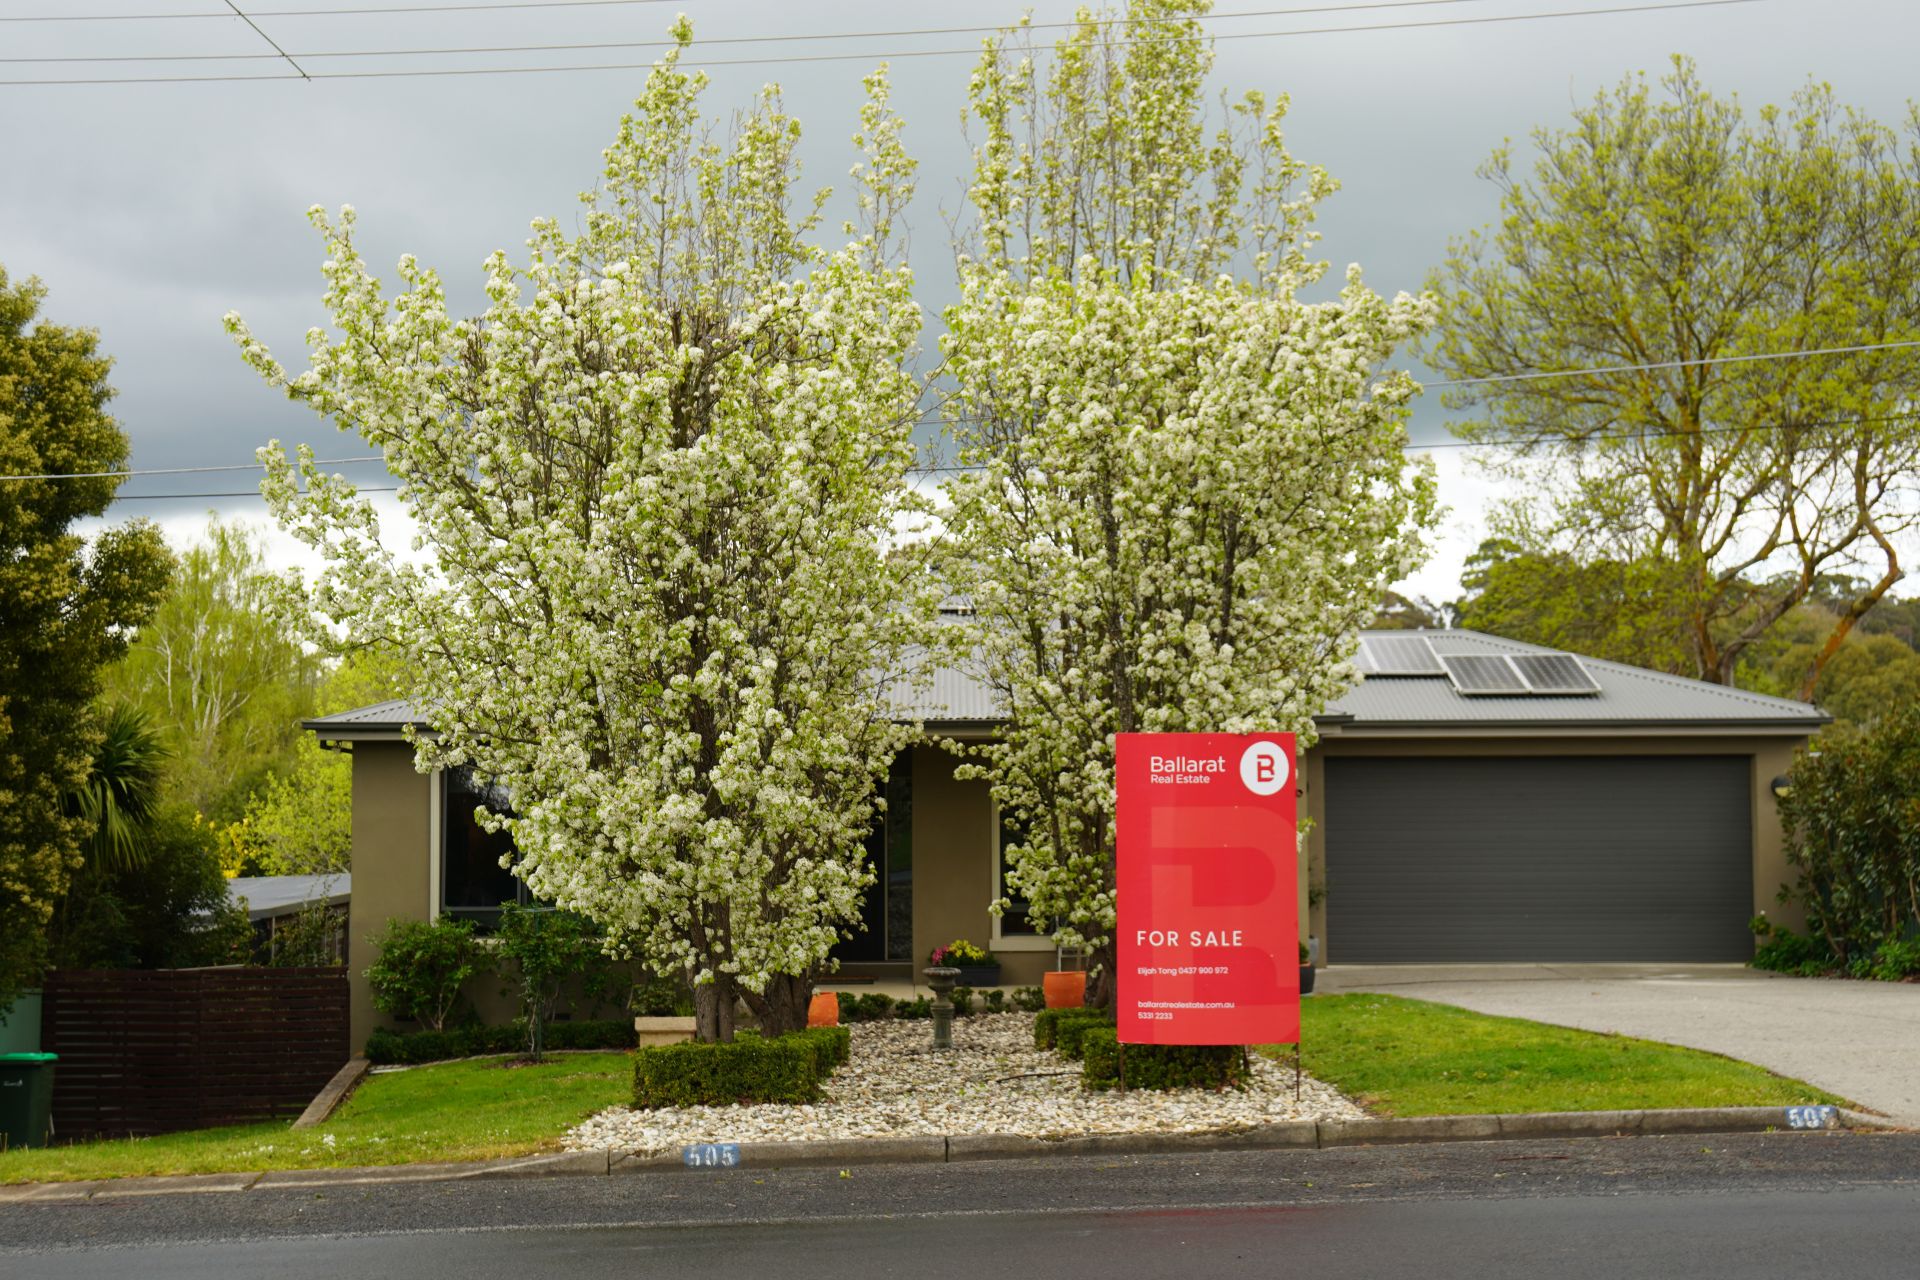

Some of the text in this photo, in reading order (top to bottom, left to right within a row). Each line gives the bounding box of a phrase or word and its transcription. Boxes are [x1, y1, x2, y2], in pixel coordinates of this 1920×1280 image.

[1150, 755, 1226, 773] Ballarat
[1256, 754, 1275, 783] B
[1150, 774, 1211, 784] Real Estate
[1136, 930, 1243, 947] FOR SALE
[1137, 967, 1157, 976] Elijah
[1158, 967, 1178, 977] Tong
[1178, 966, 1197, 974] 0437
[1214, 966, 1229, 974] 972
[1137, 1001, 1236, 1009] ballaratrealestate.com.au
[1137, 1011, 1154, 1019] 5331
